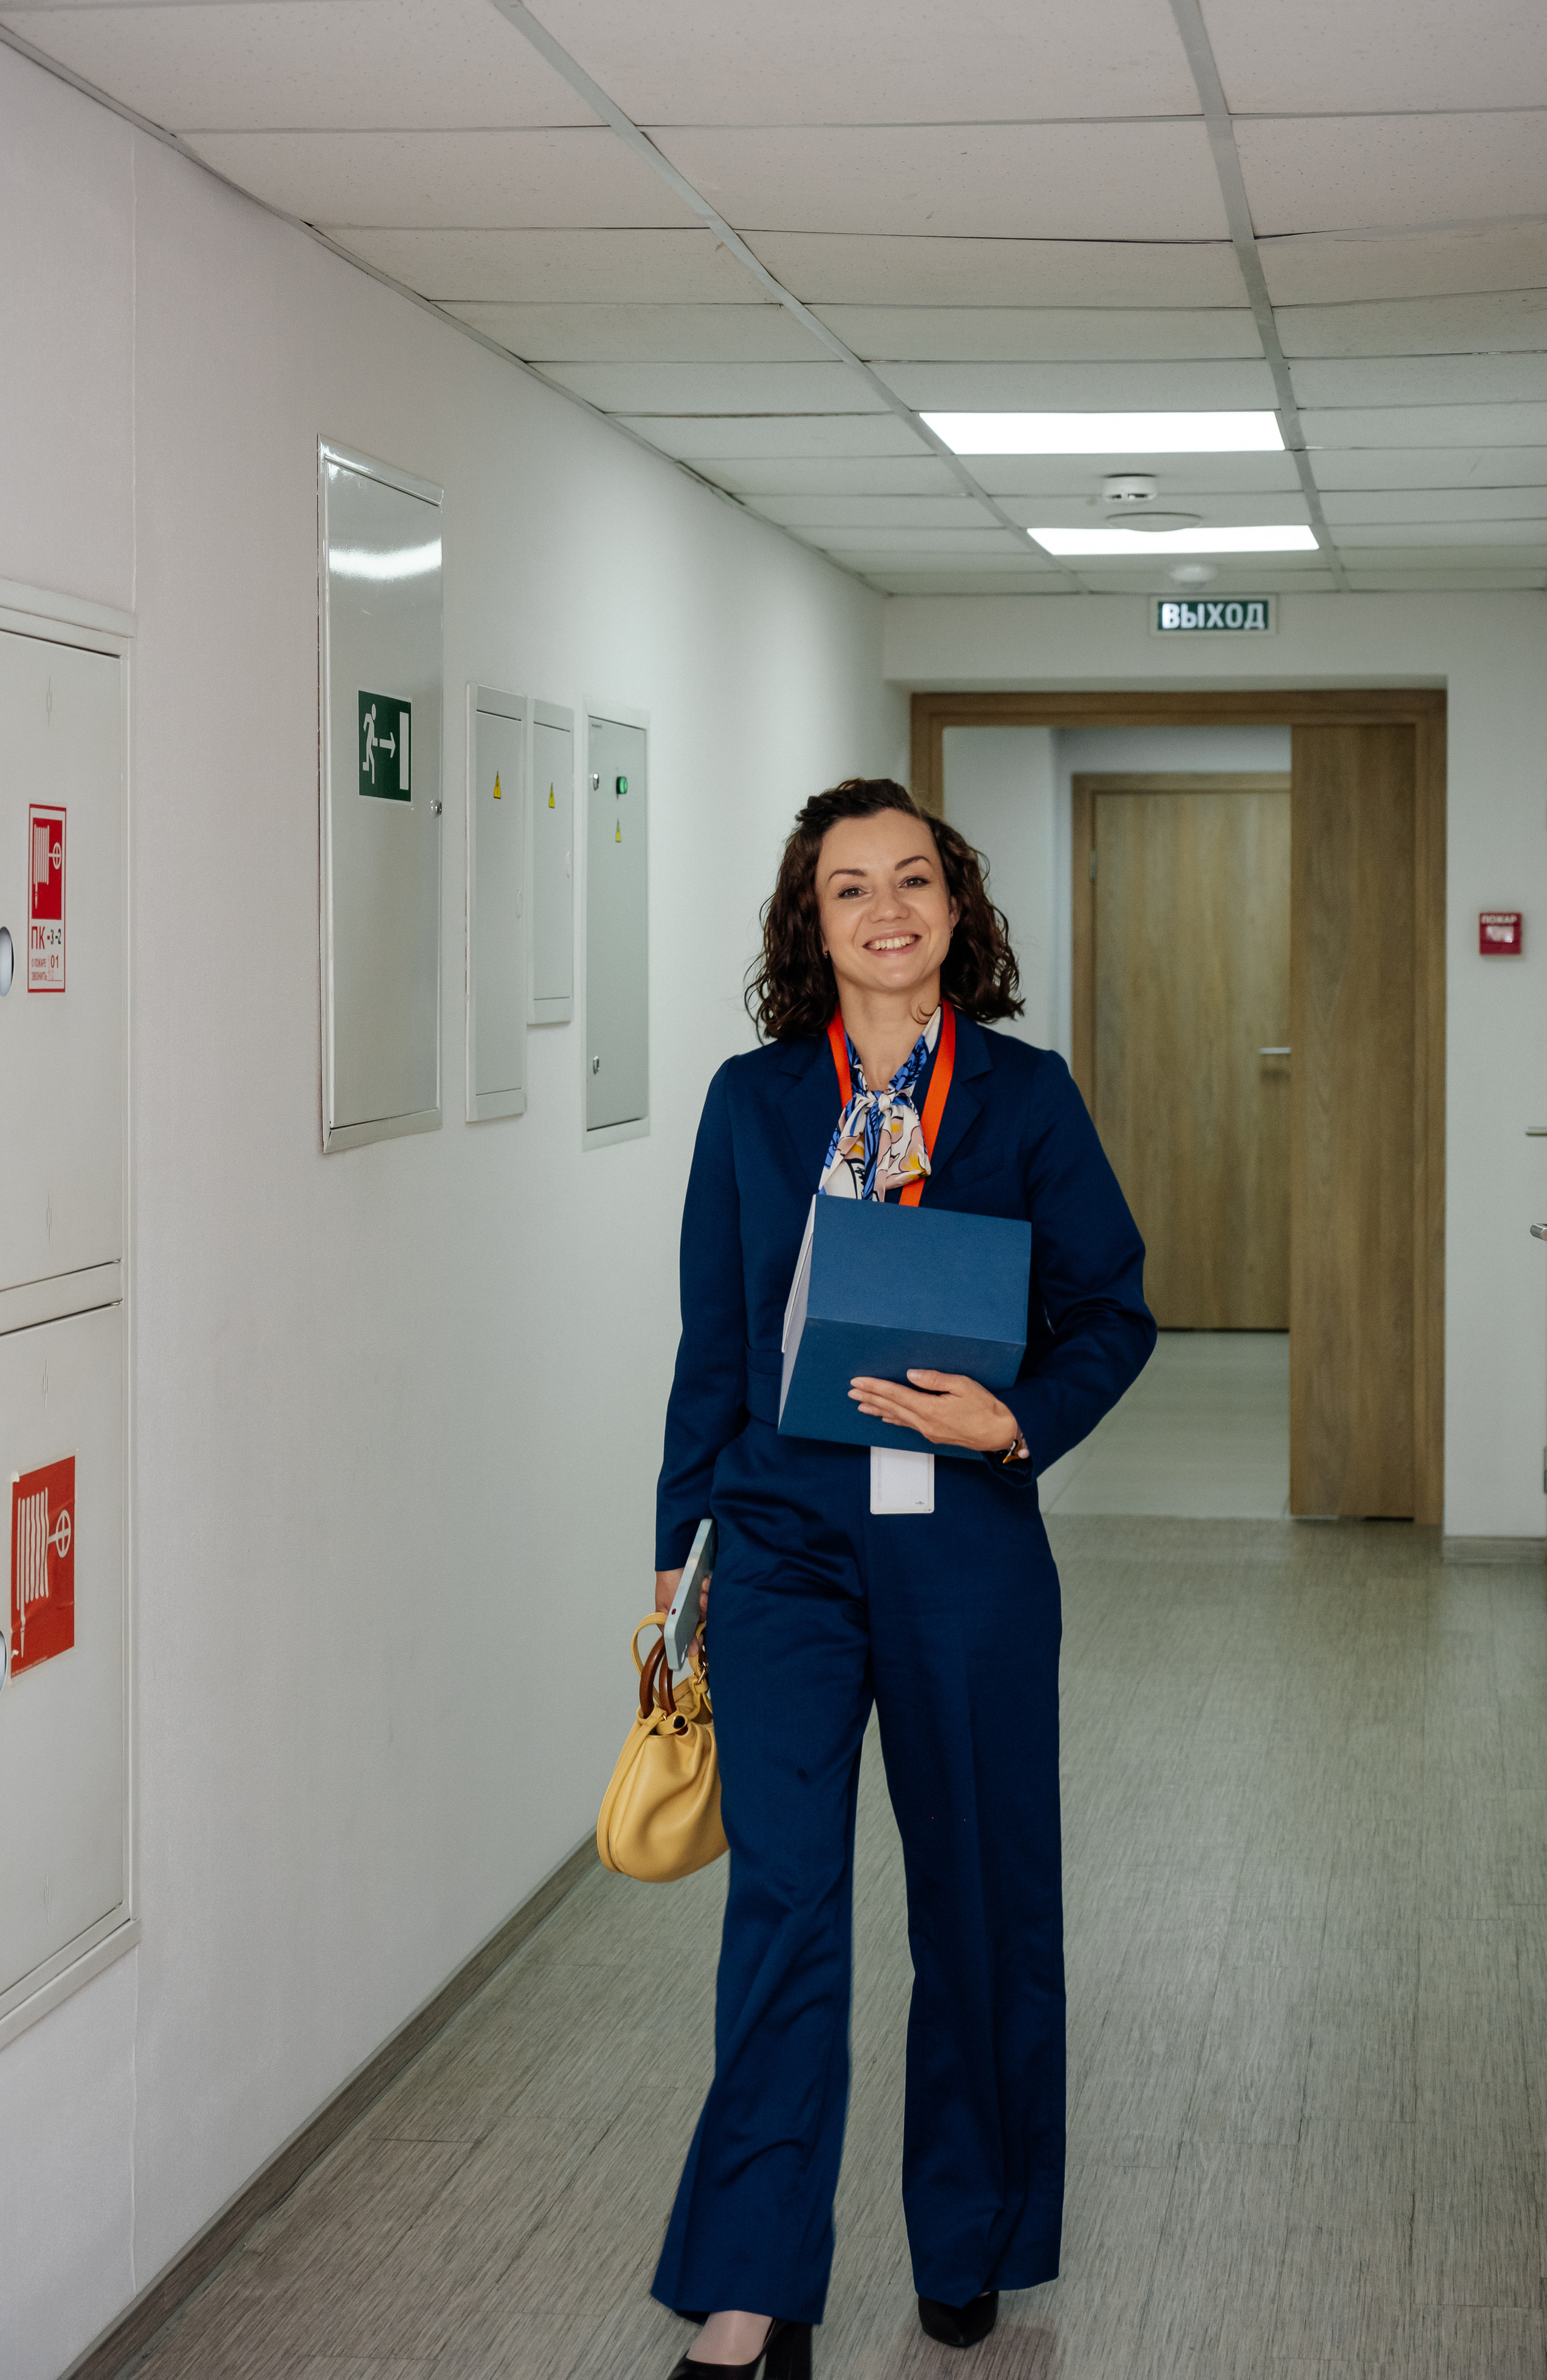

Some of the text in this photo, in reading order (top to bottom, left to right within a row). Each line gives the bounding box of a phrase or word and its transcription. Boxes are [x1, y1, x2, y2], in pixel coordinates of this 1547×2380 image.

[1161, 603, 1265, 629] ВЫХОД
[1481, 914, 1517, 924] ПОЖАР
[50, 954, 59, 968] 01
